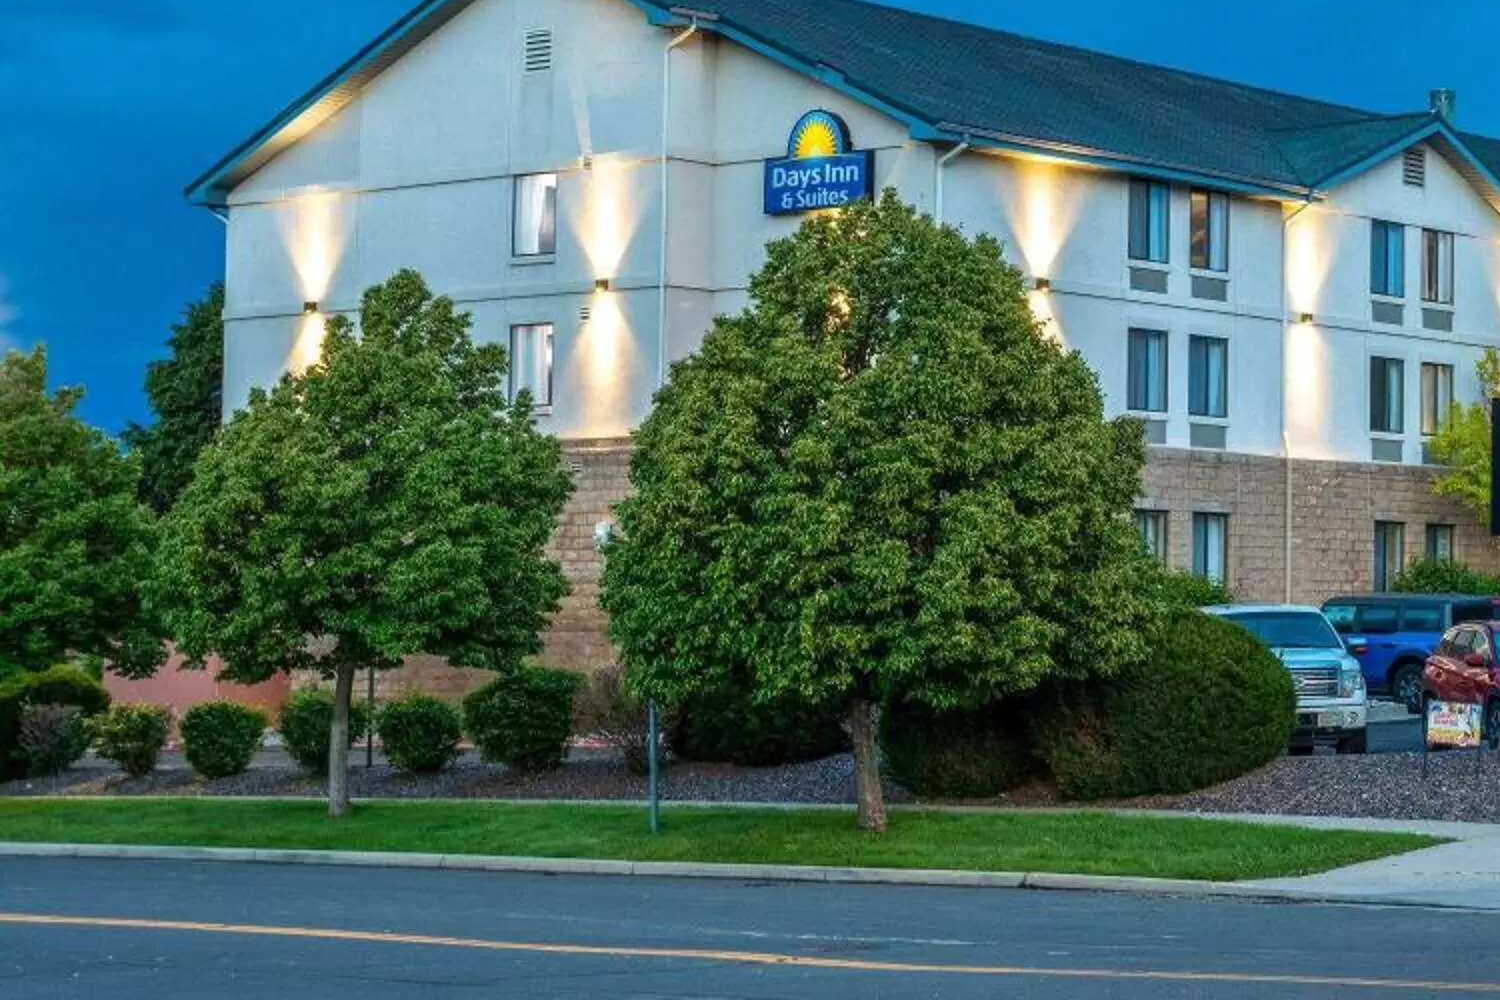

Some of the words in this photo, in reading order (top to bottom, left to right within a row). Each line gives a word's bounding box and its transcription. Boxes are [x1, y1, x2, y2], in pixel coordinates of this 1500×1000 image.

[771, 168, 821, 188] Days
[825, 163, 859, 184] Inn
[781, 191, 794, 209] &
[795, 187, 849, 207] Suites
